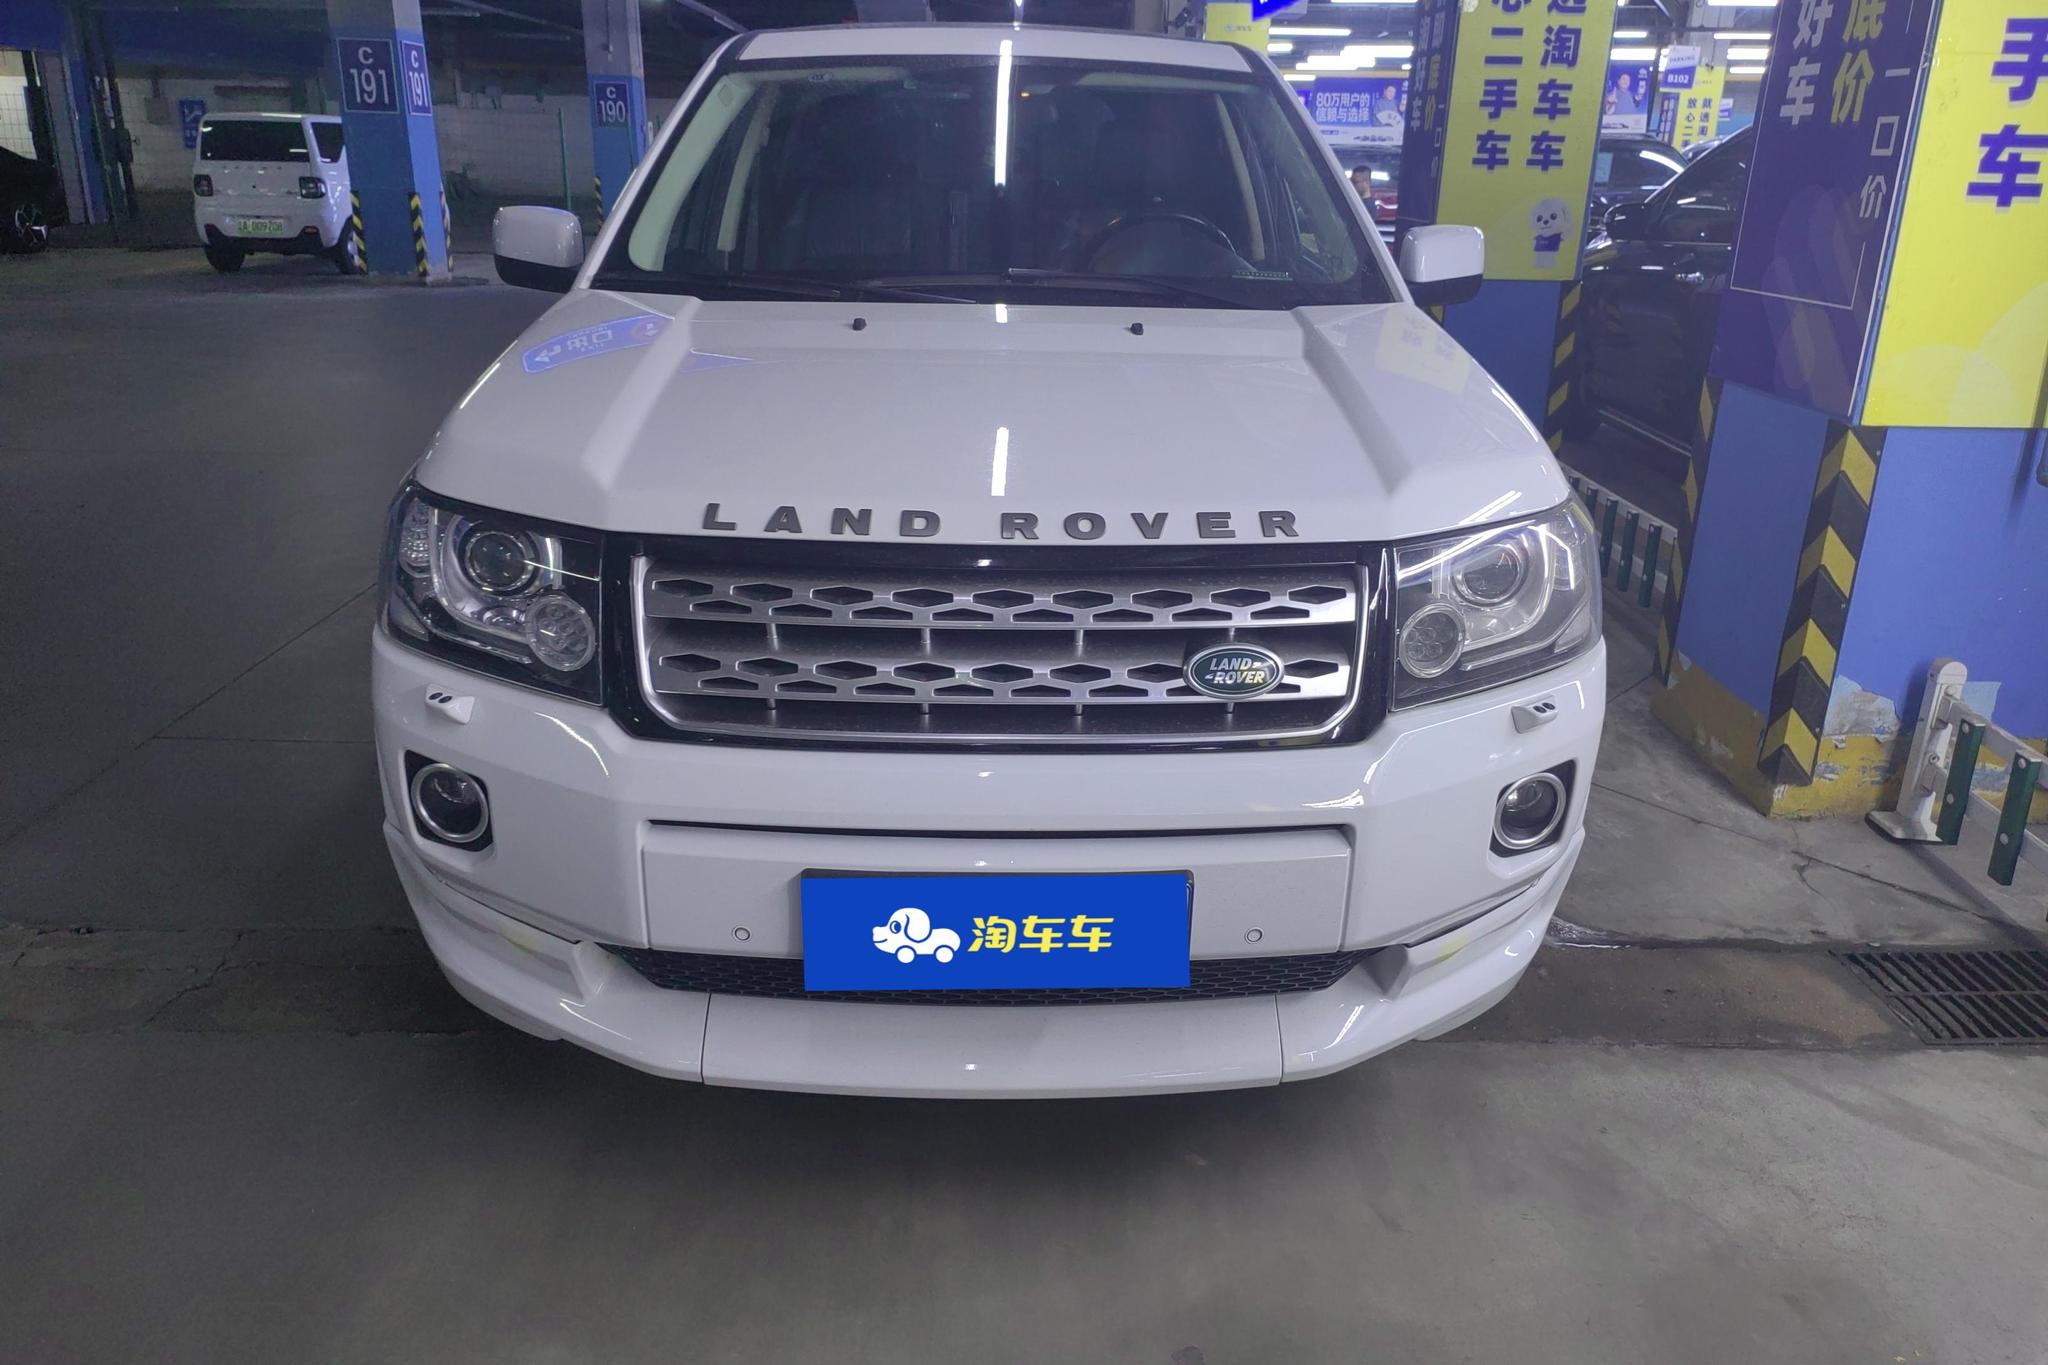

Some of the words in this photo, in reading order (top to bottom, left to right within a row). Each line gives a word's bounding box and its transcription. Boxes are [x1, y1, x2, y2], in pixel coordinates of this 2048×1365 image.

[358, 47, 374, 64] C
[411, 50, 419, 68] C
[1780, 0, 1833, 125] 好车
[350, 68, 389, 104] 191
[1667, 74, 1689, 84] B102
[409, 71, 428, 107] 191
[606, 87, 616, 99] C
[1316, 92, 1370, 107] 80万用户的
[599, 101, 626, 123] 190
[1316, 107, 1370, 122] 信赖与选择
[1859, 68, 1910, 218] 一口价
[702, 503, 941, 537] LAND
[1000, 509, 1300, 541] ROVER
[1210, 658, 1252, 670] LAND
[1214, 671, 1265, 684] ROVER
